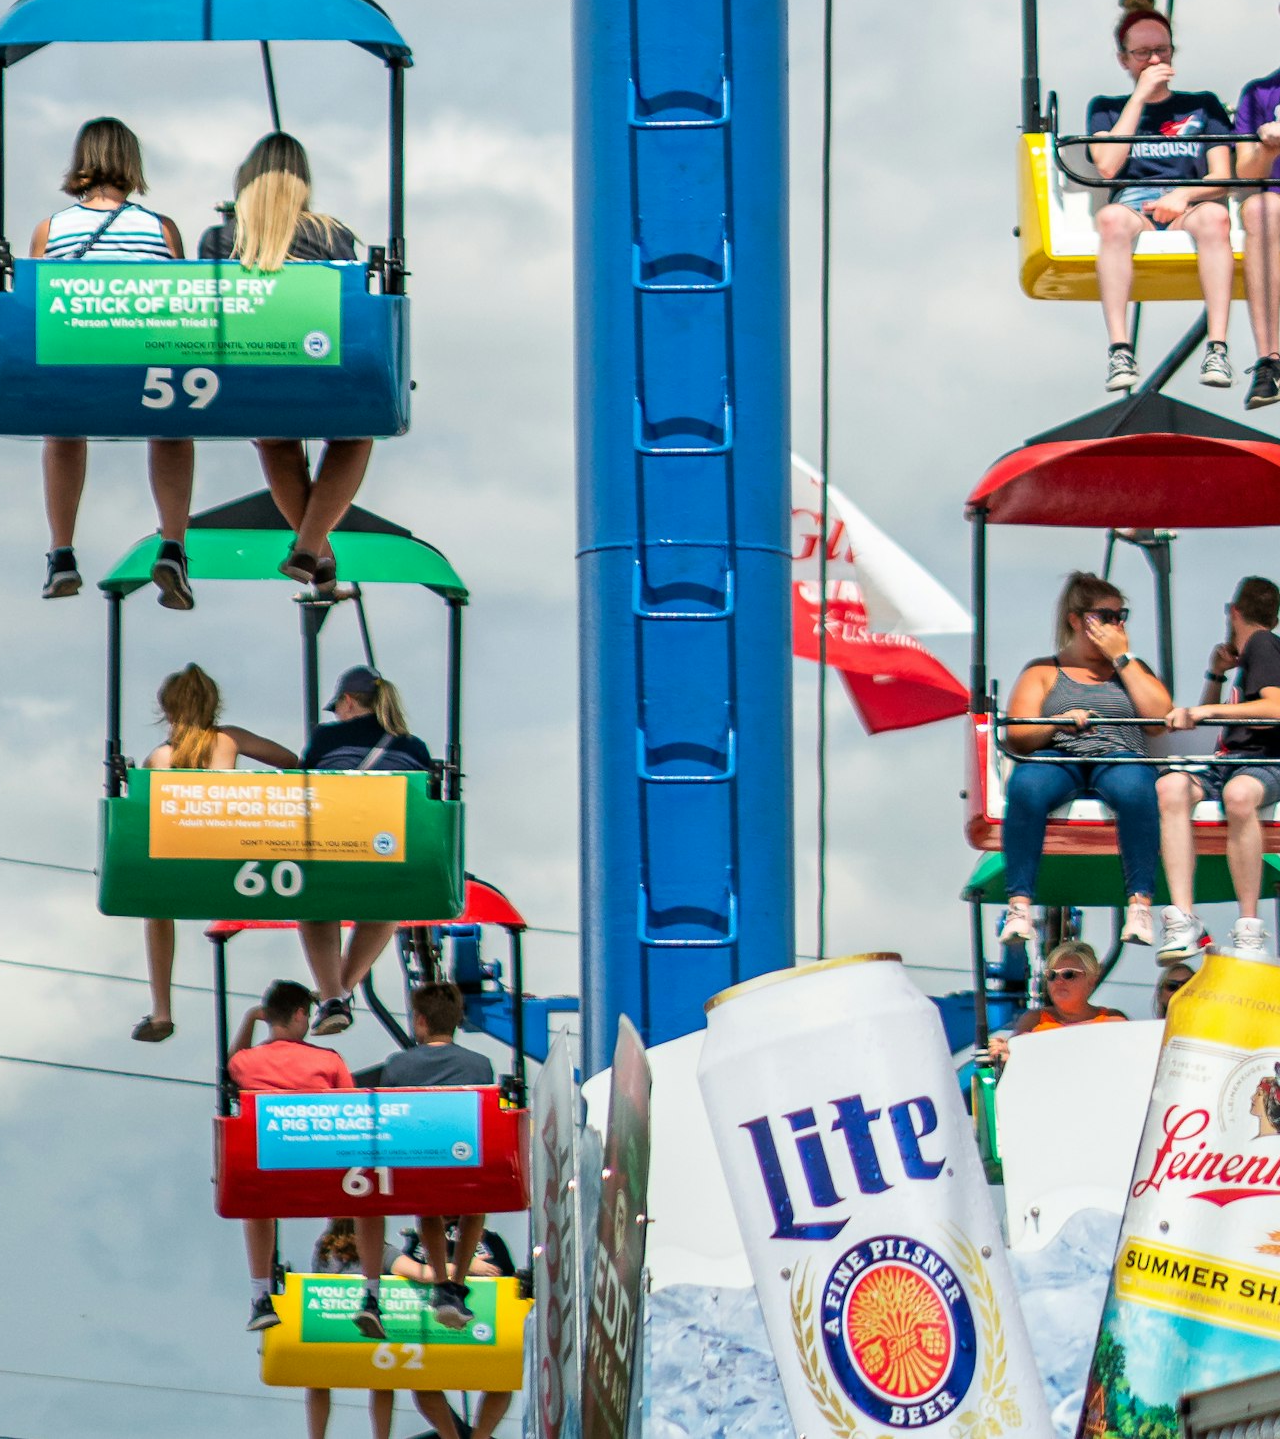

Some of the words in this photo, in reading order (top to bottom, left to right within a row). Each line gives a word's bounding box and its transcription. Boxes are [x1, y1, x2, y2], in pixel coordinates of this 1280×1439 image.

[1131, 142, 1200, 158] NEROUSLY
[50, 279, 108, 296] “YOU
[109, 279, 175, 296] CAN’T
[177, 279, 232, 295] DEEP
[236, 279, 277, 295] FRY
[50, 297, 67, 314] A
[71, 297, 131, 314] STICK
[135, 297, 166, 314] OF
[169, 297, 265, 314] BUTTER.”
[71, 318, 107, 328] Person
[110, 318, 144, 328] Who’s
[146, 318, 178, 328] Never
[180, 318, 206, 328] Tried
[209, 318, 218, 328] It
[141, 367, 219, 410] 59
[161, 785, 204, 799] “THE
[208, 786, 261, 799] GIANT
[266, 786, 317, 800] SLIDE
[161, 801, 176, 814] IS
[180, 801, 223, 815] JUST
[227, 802, 262, 815] FOR
[269, 802, 323, 816] KIDS.”
[233, 861, 303, 897] 60
[341, 1165, 394, 1198] 61
[738, 1093, 947, 1241] Lite
[826, 1249, 865, 1313] FINE
[871, 1238, 962, 1305] PILSNER
[1124, 1249, 1229, 1292] SUMMER
[824, 1317, 841, 1338] A
[372, 1343, 426, 1370] 62
[889, 1393, 957, 1426] BEER
